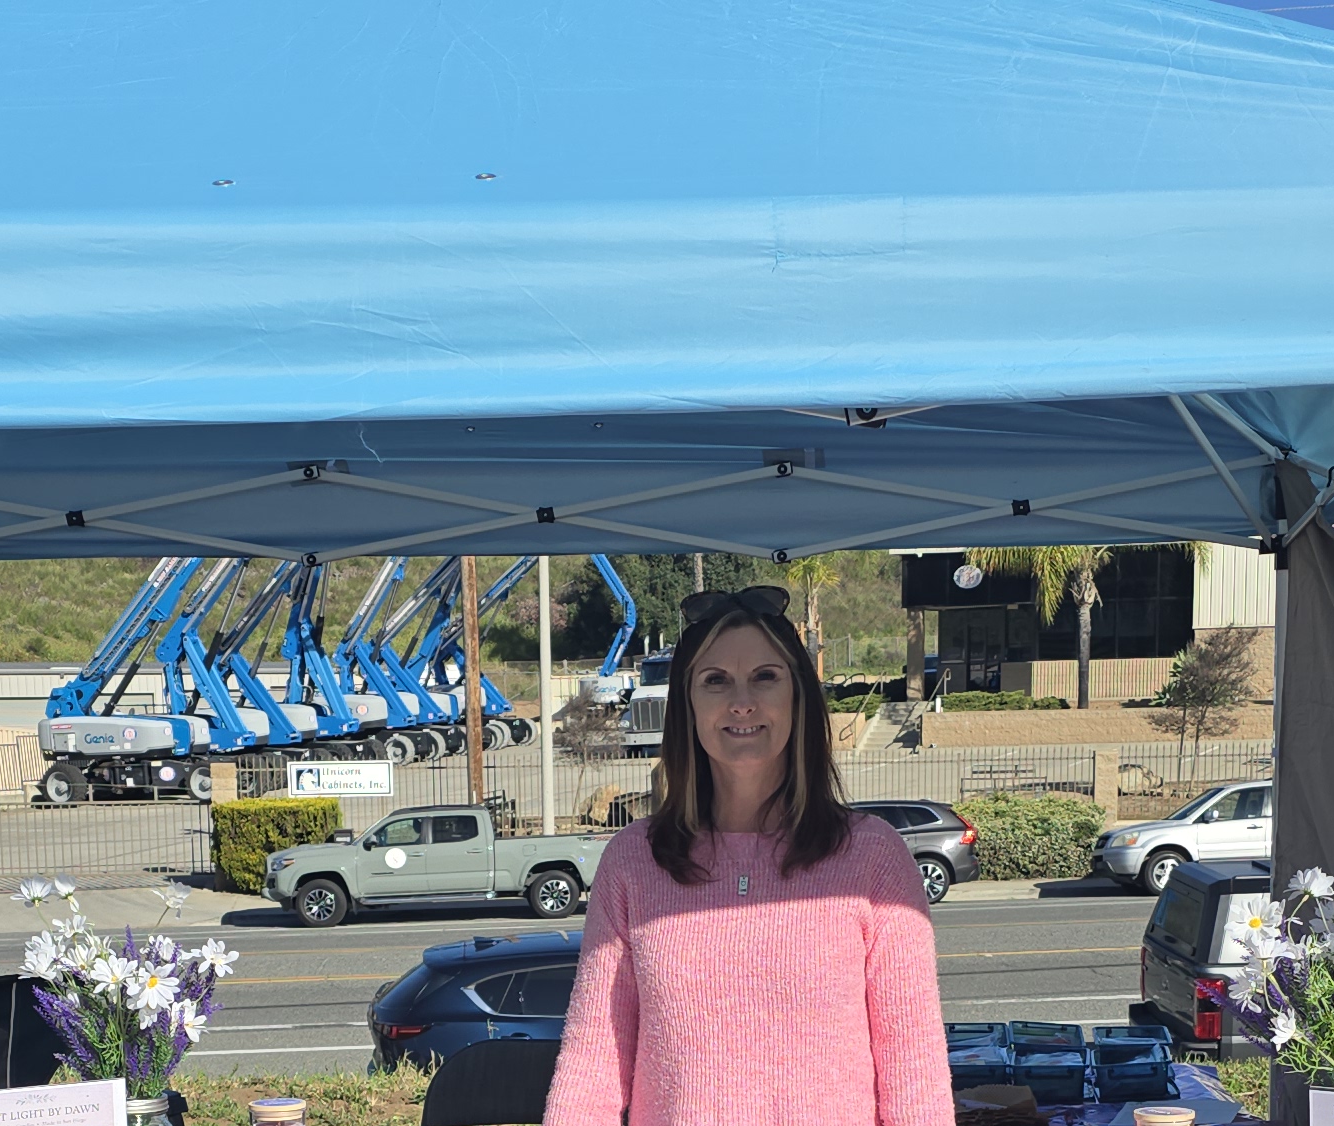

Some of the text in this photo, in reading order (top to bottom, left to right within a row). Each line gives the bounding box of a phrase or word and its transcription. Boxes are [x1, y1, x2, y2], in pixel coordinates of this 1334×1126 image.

[84, 733, 115, 744] Genie
[322, 767, 362, 776] Unicorn
[321, 780, 387, 790] Cabinets, Inc.
[10, 1109, 44, 1120] LIGHT
[48, 1107, 62, 1116] BY
[65, 1103, 100, 1115] DAWN
